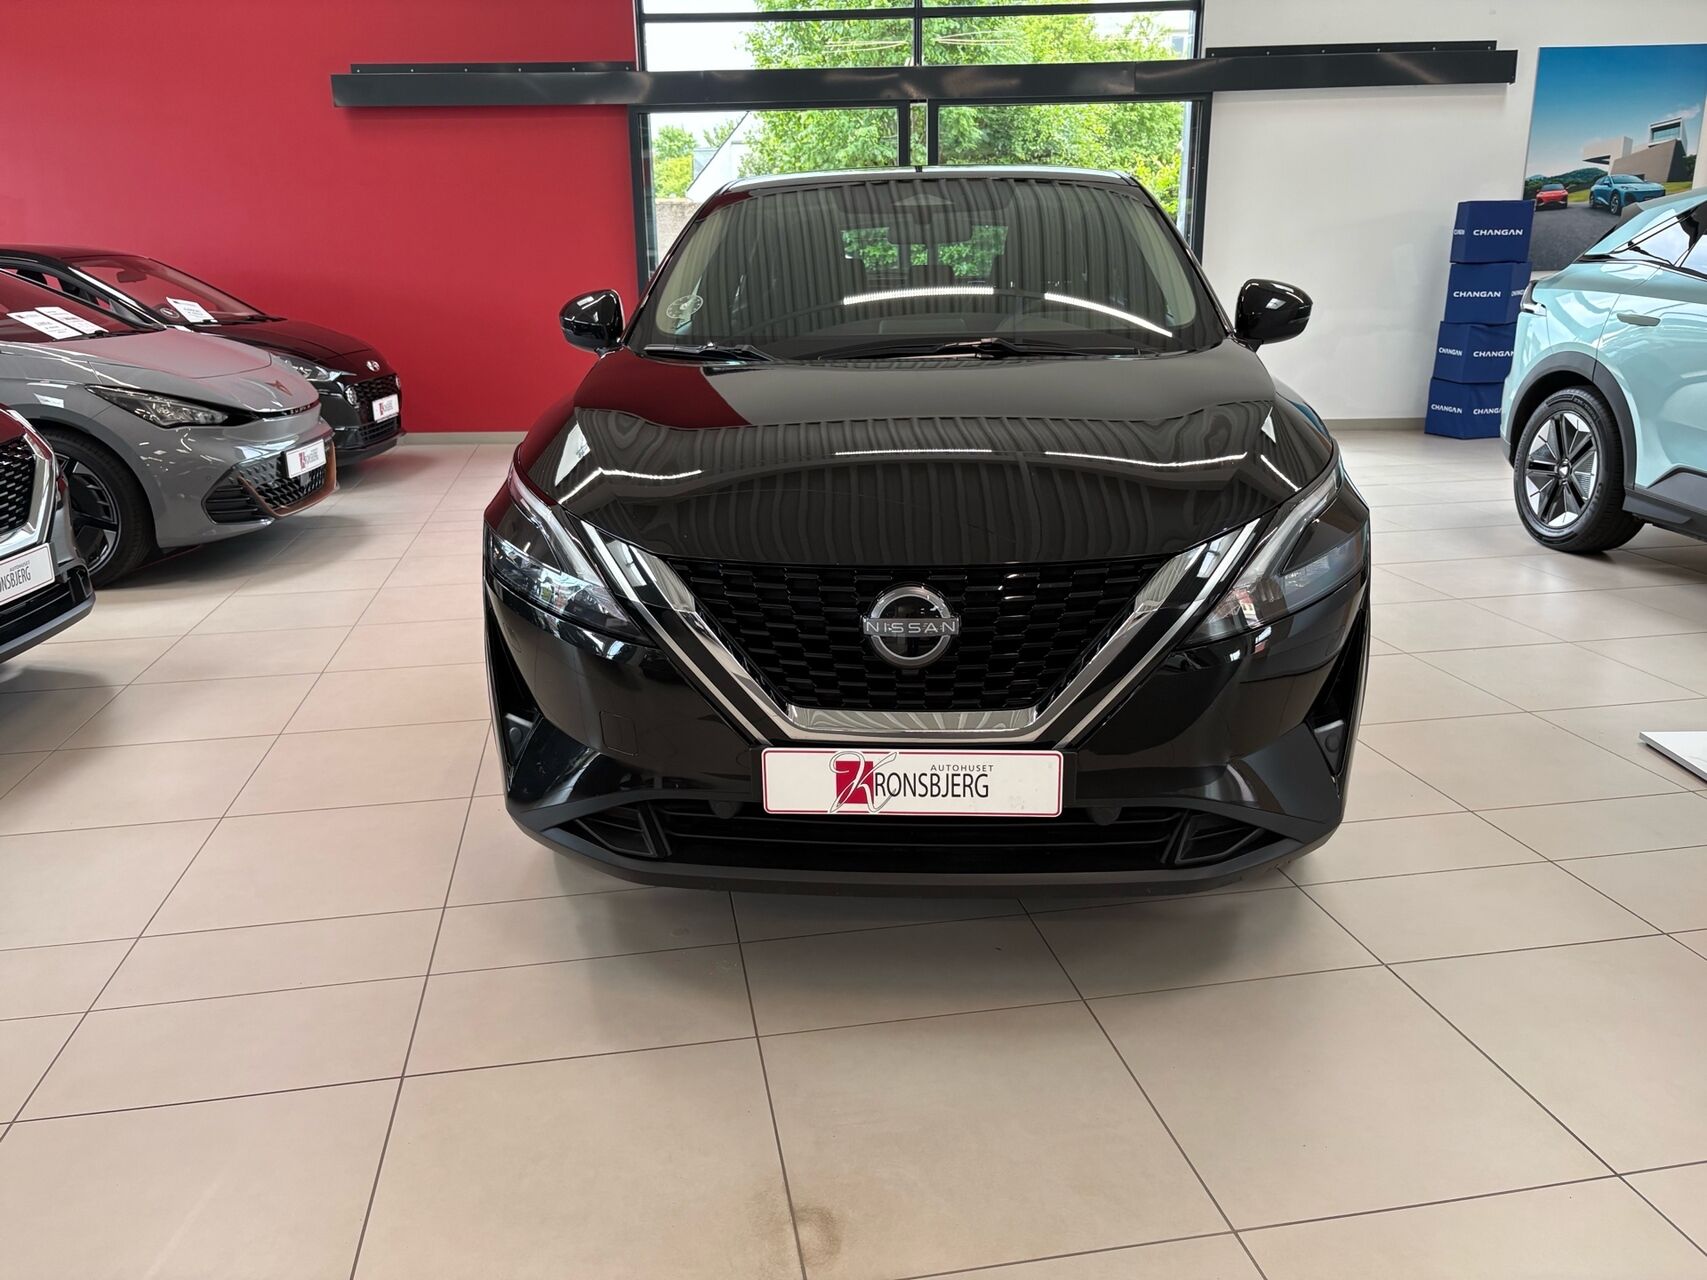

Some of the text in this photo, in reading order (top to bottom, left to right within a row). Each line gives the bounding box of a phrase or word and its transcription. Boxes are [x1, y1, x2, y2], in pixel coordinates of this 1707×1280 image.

[1438, 347, 1463, 356] CHANGAN
[1431, 404, 1463, 414] CHANGAN
[0, 566, 31, 593] NSBJERG
[866, 621, 955, 633] NISSAN
[930, 764, 994, 772] AUTOHUSET
